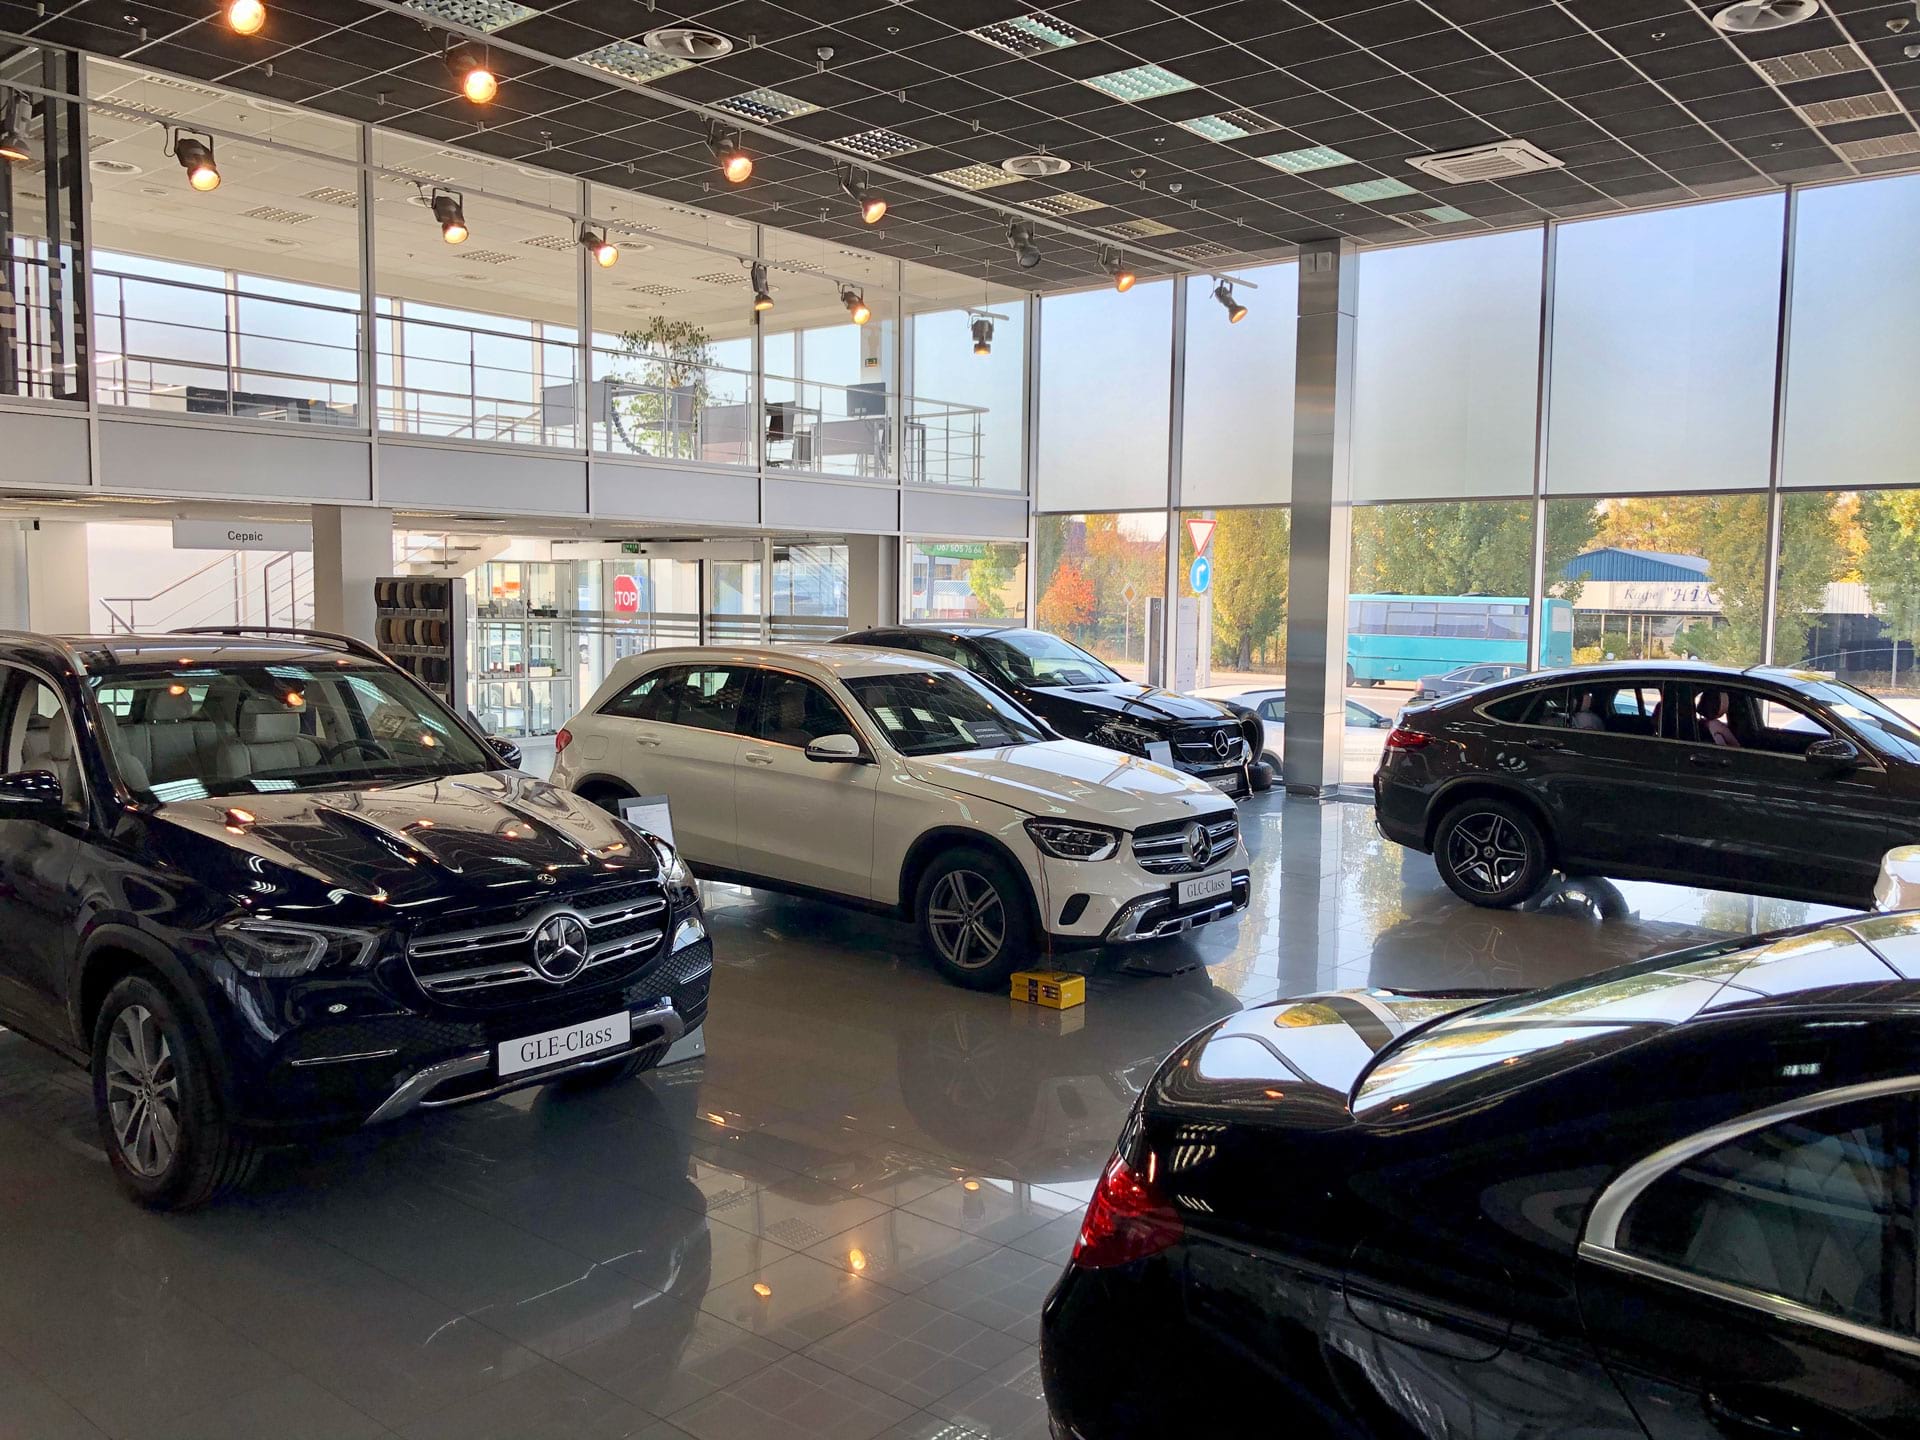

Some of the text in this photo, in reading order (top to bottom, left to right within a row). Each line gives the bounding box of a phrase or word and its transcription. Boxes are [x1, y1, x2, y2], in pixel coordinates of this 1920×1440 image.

[227, 530, 264, 543] Сервіс
[1186, 879, 1225, 898] GLC-Class
[520, 1027, 613, 1063] GLE-Class
